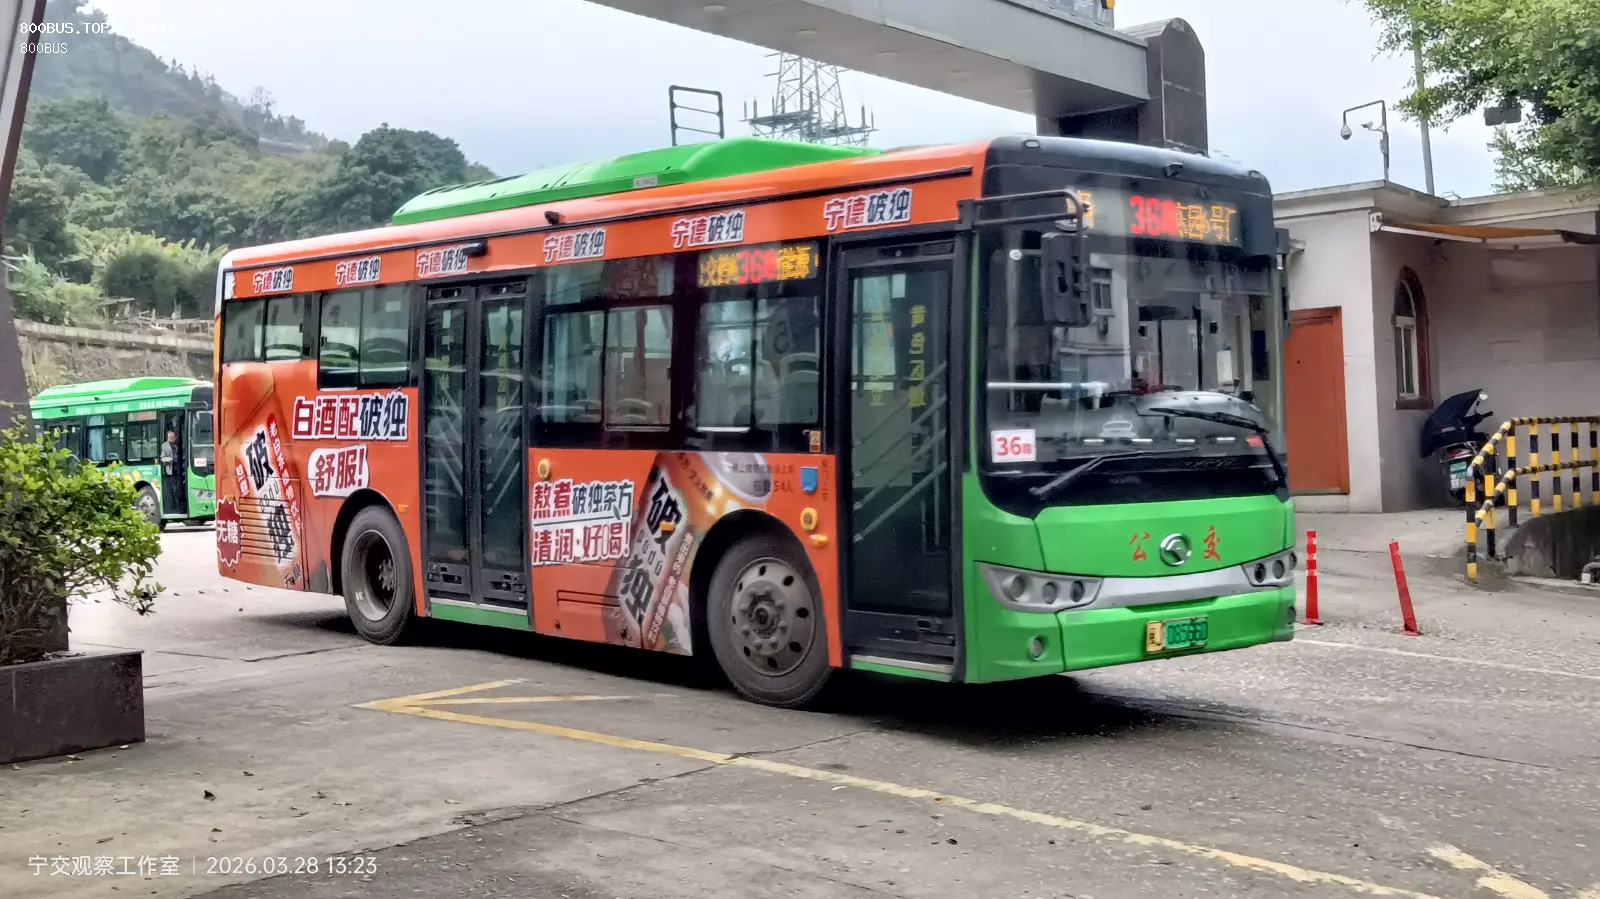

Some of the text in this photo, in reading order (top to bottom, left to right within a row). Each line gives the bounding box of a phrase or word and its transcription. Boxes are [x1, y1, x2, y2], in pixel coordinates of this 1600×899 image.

[823, 189, 913, 230] 宁德破独
[543, 229, 606, 263] 宁德破独
[671, 212, 746, 247] 宁德破独
[253, 267, 293, 293] 宁德破独
[336, 257, 381, 284] 宁德破独
[293, 396, 407, 438] 白酒配破独
[315, 448, 365, 492] 舒服!
[533, 481, 634, 520] 熬煮破独茶方
[216, 519, 238, 545] 无糖
[1128, 525, 1221, 562] 公 交
